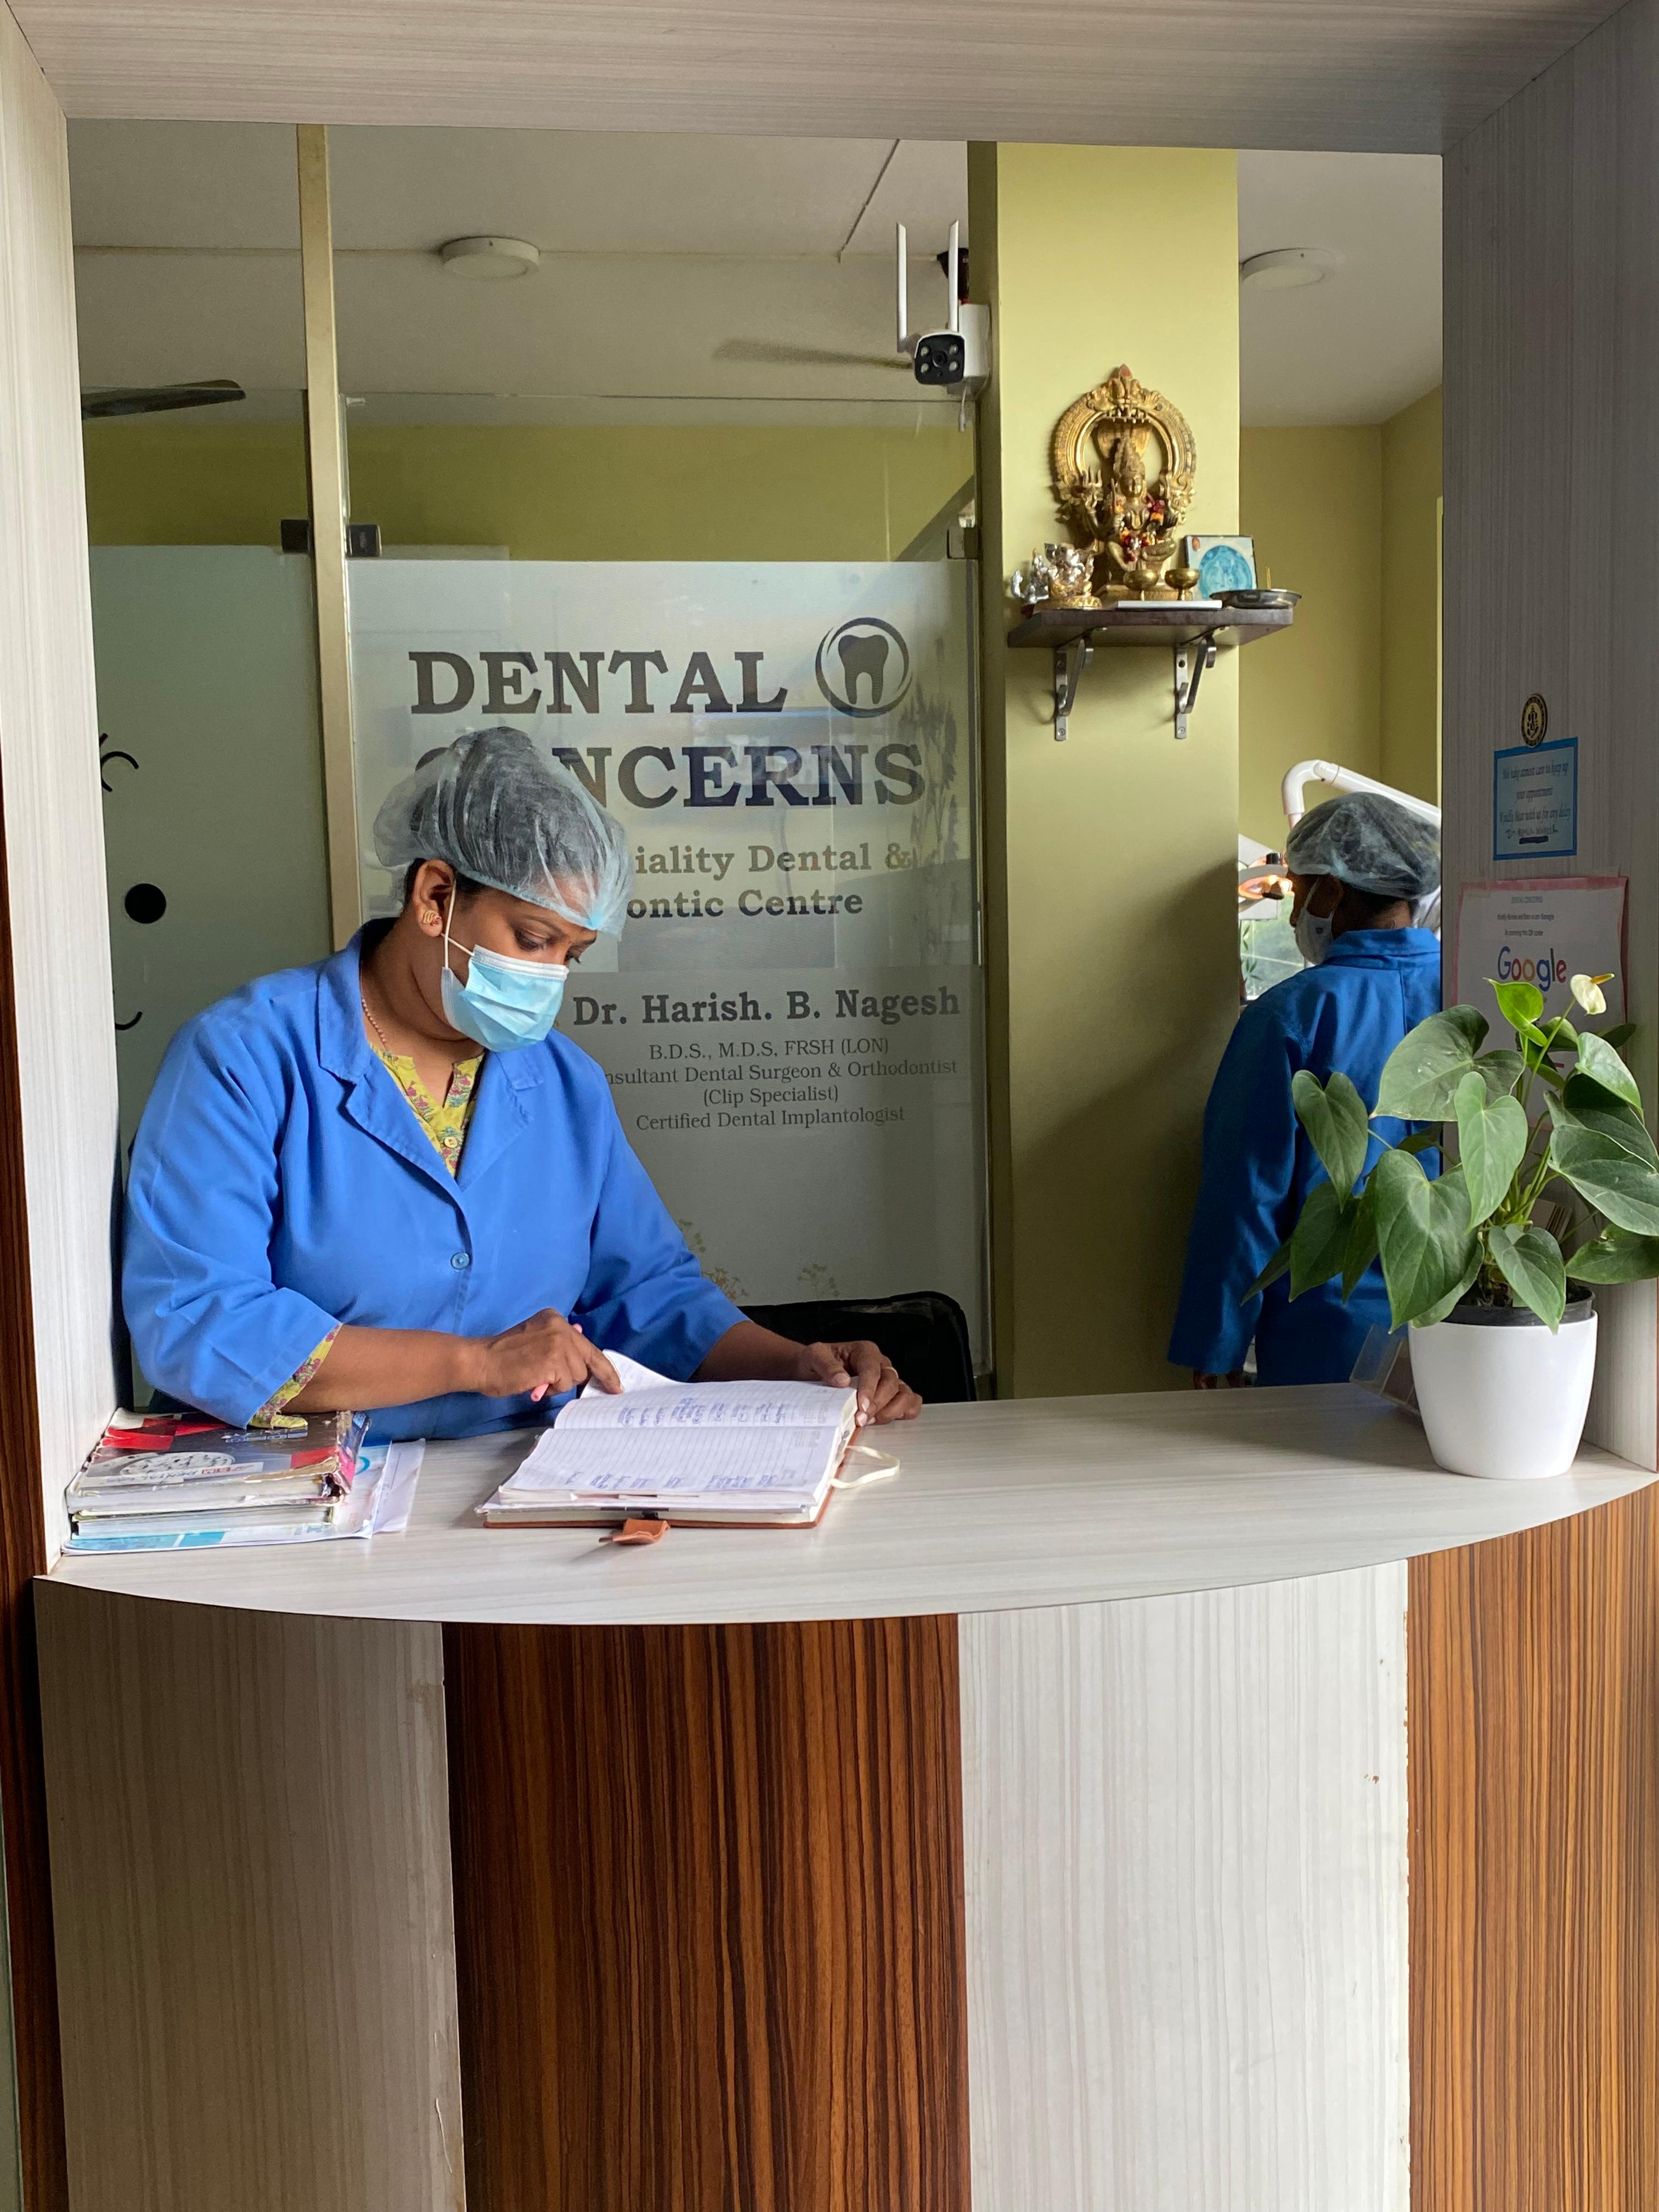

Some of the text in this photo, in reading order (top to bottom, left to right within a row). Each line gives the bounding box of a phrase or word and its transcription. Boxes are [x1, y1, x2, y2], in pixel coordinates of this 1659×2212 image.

[409, 651, 787, 714] DENTAL
[415, 743, 926, 808] NCERNS
[635, 842, 911, 881] iality Dental &
[627, 889, 863, 918] ontic Centre
[1497, 946, 1567, 992] Google
[573, 986, 960, 1025] Dr. Harish. B. Nagesh
[649, 1043, 712, 1060] B.D.S.,
[785, 1039, 834, 1056] FRSH
[841, 1037, 888, 1056] (LON)
[605, 1059, 957, 1085] nsultant Dental Surgeon & Orthodontist
[704, 1084, 838, 1108] (Clip Specialist)
[636, 1107, 905, 1131] Certified Dental Implantologist
